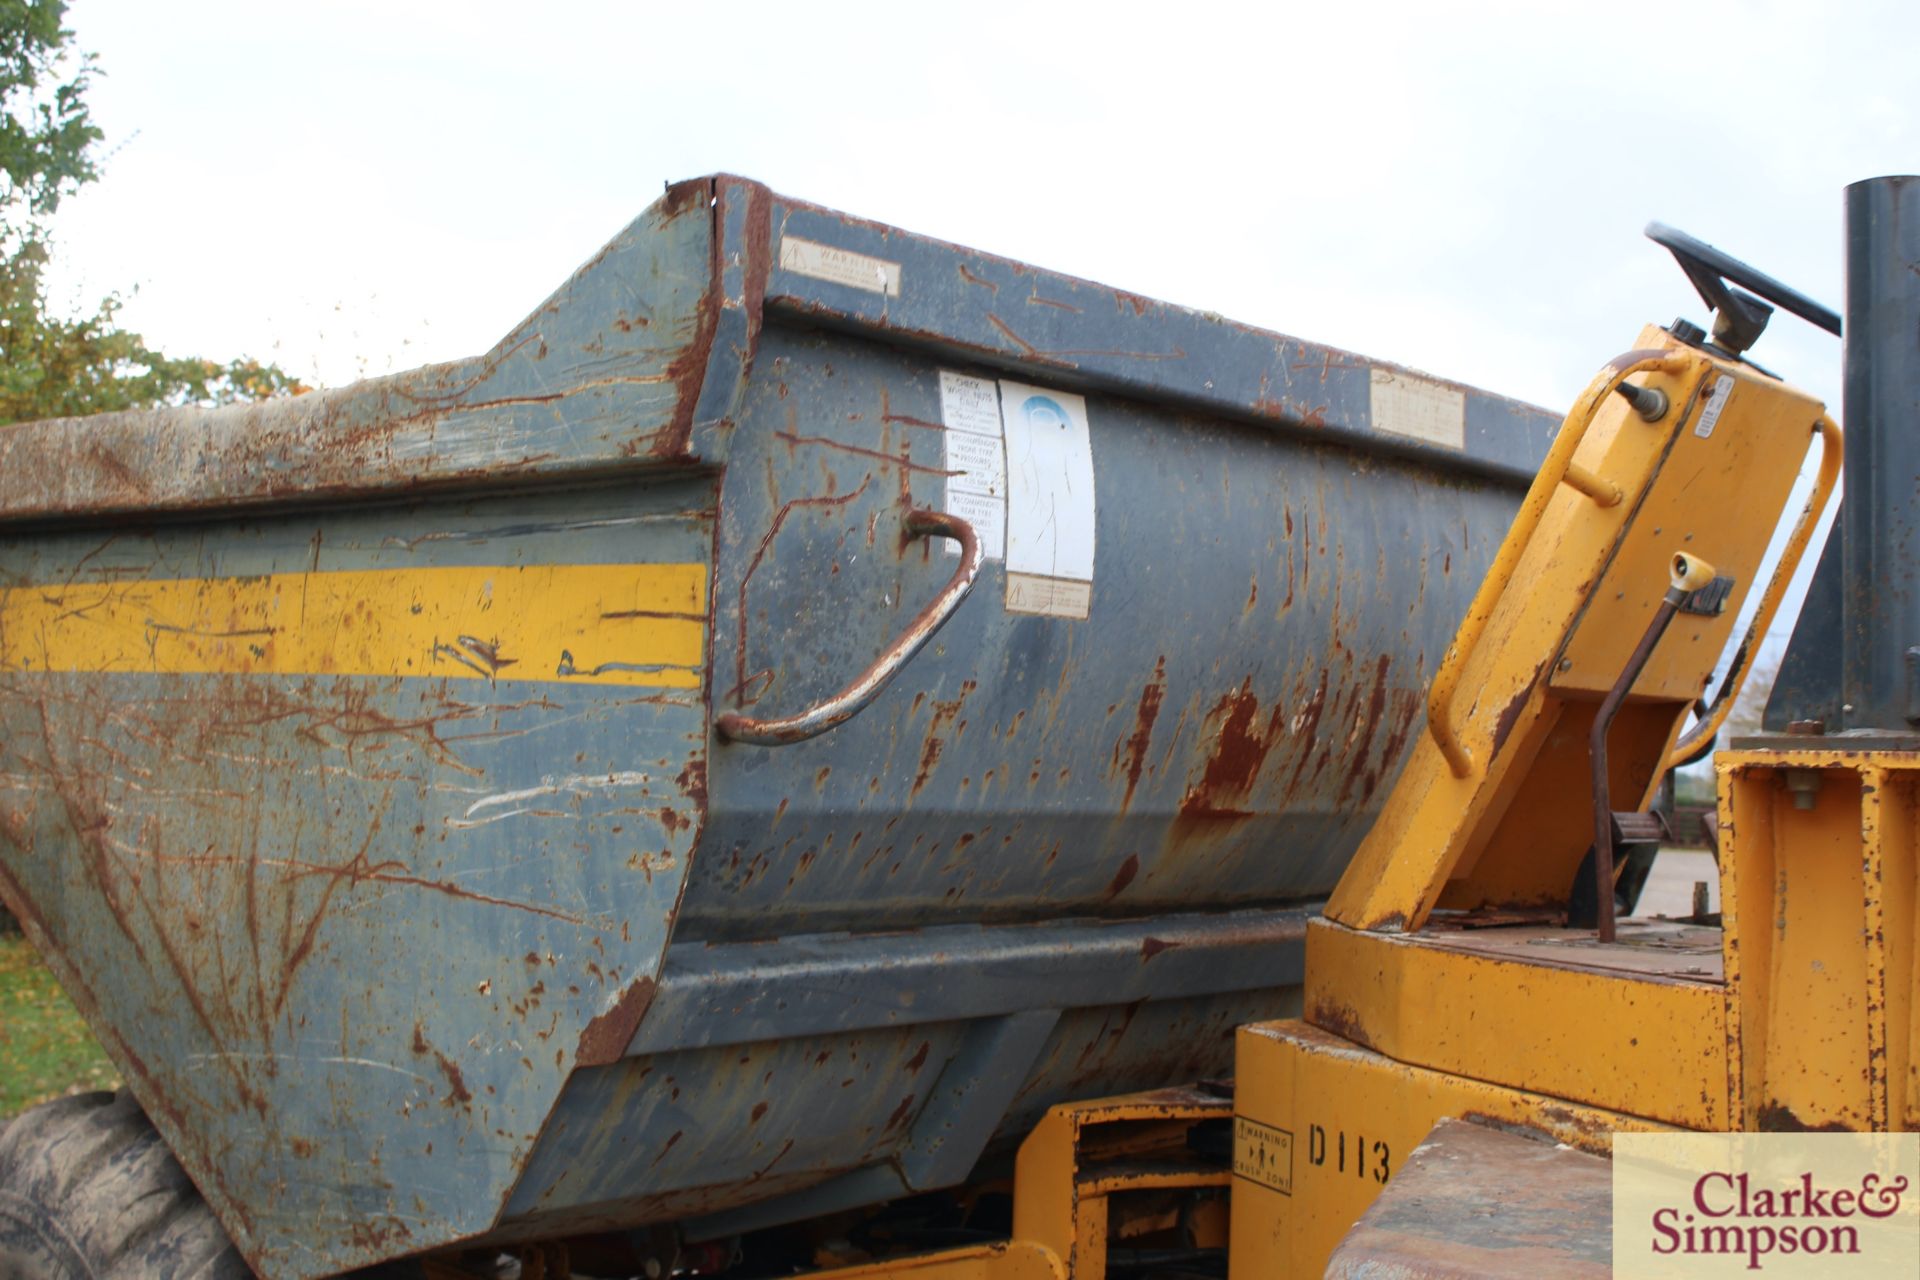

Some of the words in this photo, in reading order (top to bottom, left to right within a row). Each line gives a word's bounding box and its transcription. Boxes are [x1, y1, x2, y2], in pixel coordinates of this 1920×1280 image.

[1247, 1126, 1288, 1149] WARNING
[1309, 1123, 1390, 1185] D113
[1234, 1158, 1261, 1177] CRUSH
[1266, 1170, 1291, 1188] ZONE
